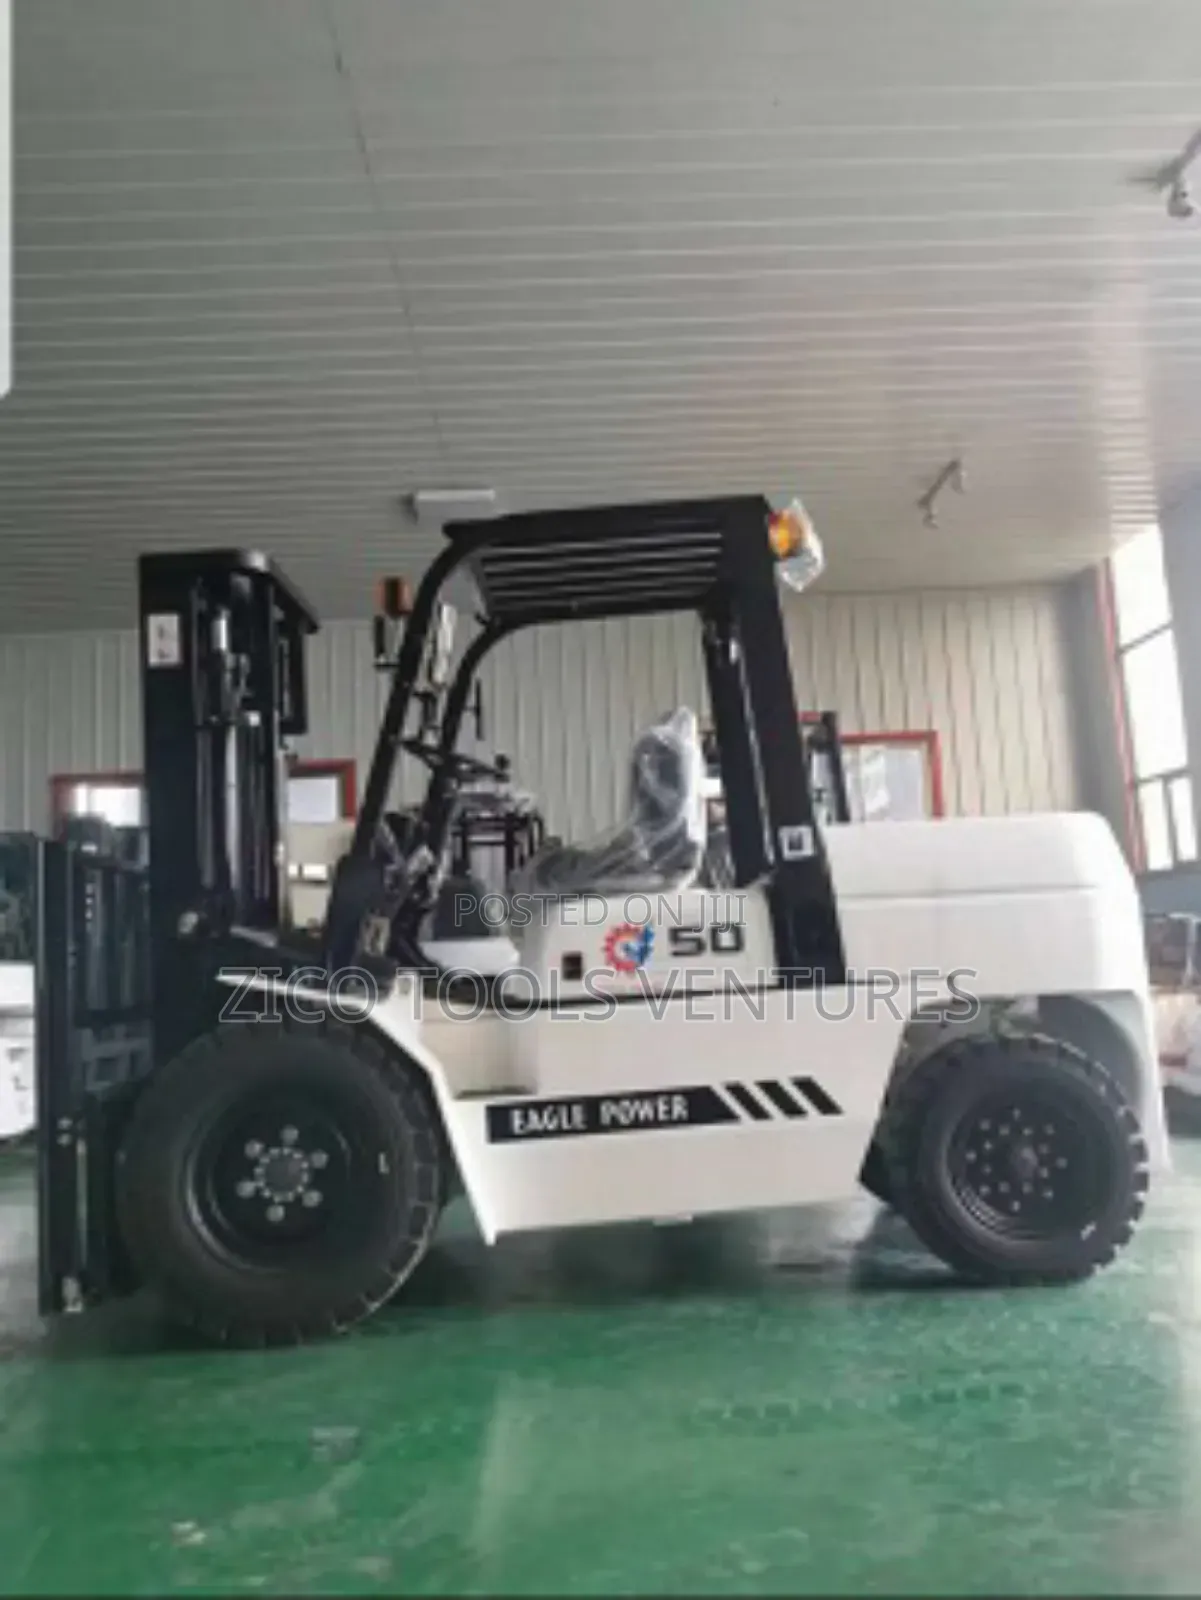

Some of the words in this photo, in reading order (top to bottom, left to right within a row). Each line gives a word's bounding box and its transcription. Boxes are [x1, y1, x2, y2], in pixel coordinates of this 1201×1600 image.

[668, 923, 745, 957] 50
[511, 1103, 588, 1136] EAGLE
[600, 1094, 689, 1127] POWER
